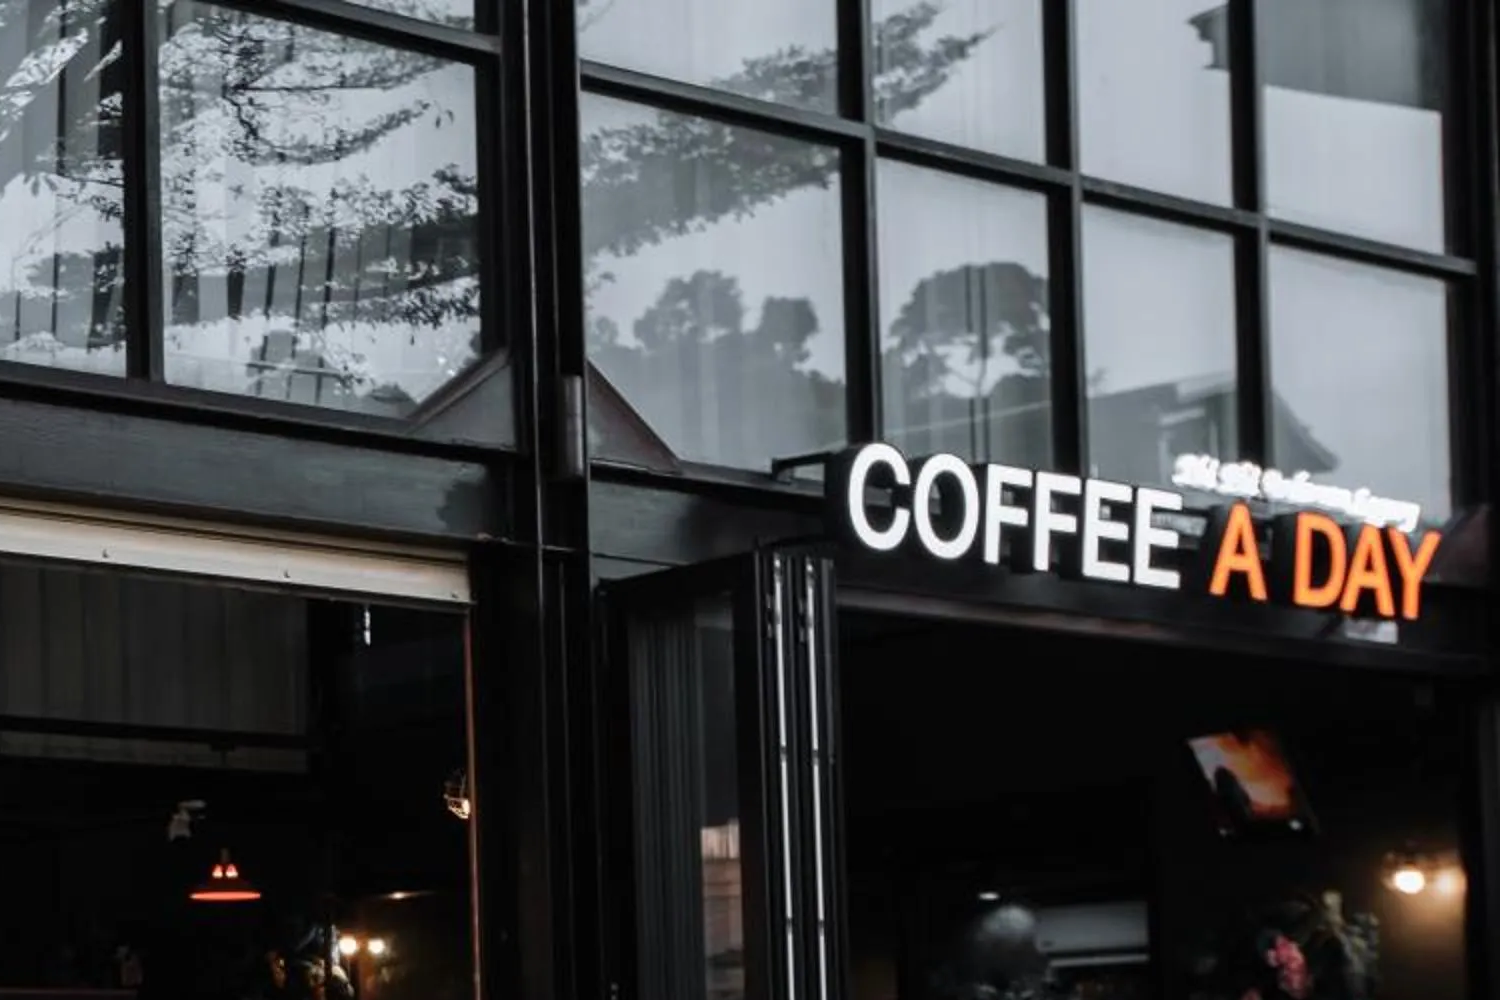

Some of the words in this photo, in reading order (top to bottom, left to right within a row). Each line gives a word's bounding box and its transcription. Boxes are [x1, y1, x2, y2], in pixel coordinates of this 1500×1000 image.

[847, 441, 1184, 590] COFFEE
[1209, 501, 1268, 602] A
[1293, 511, 1442, 621] DAY
